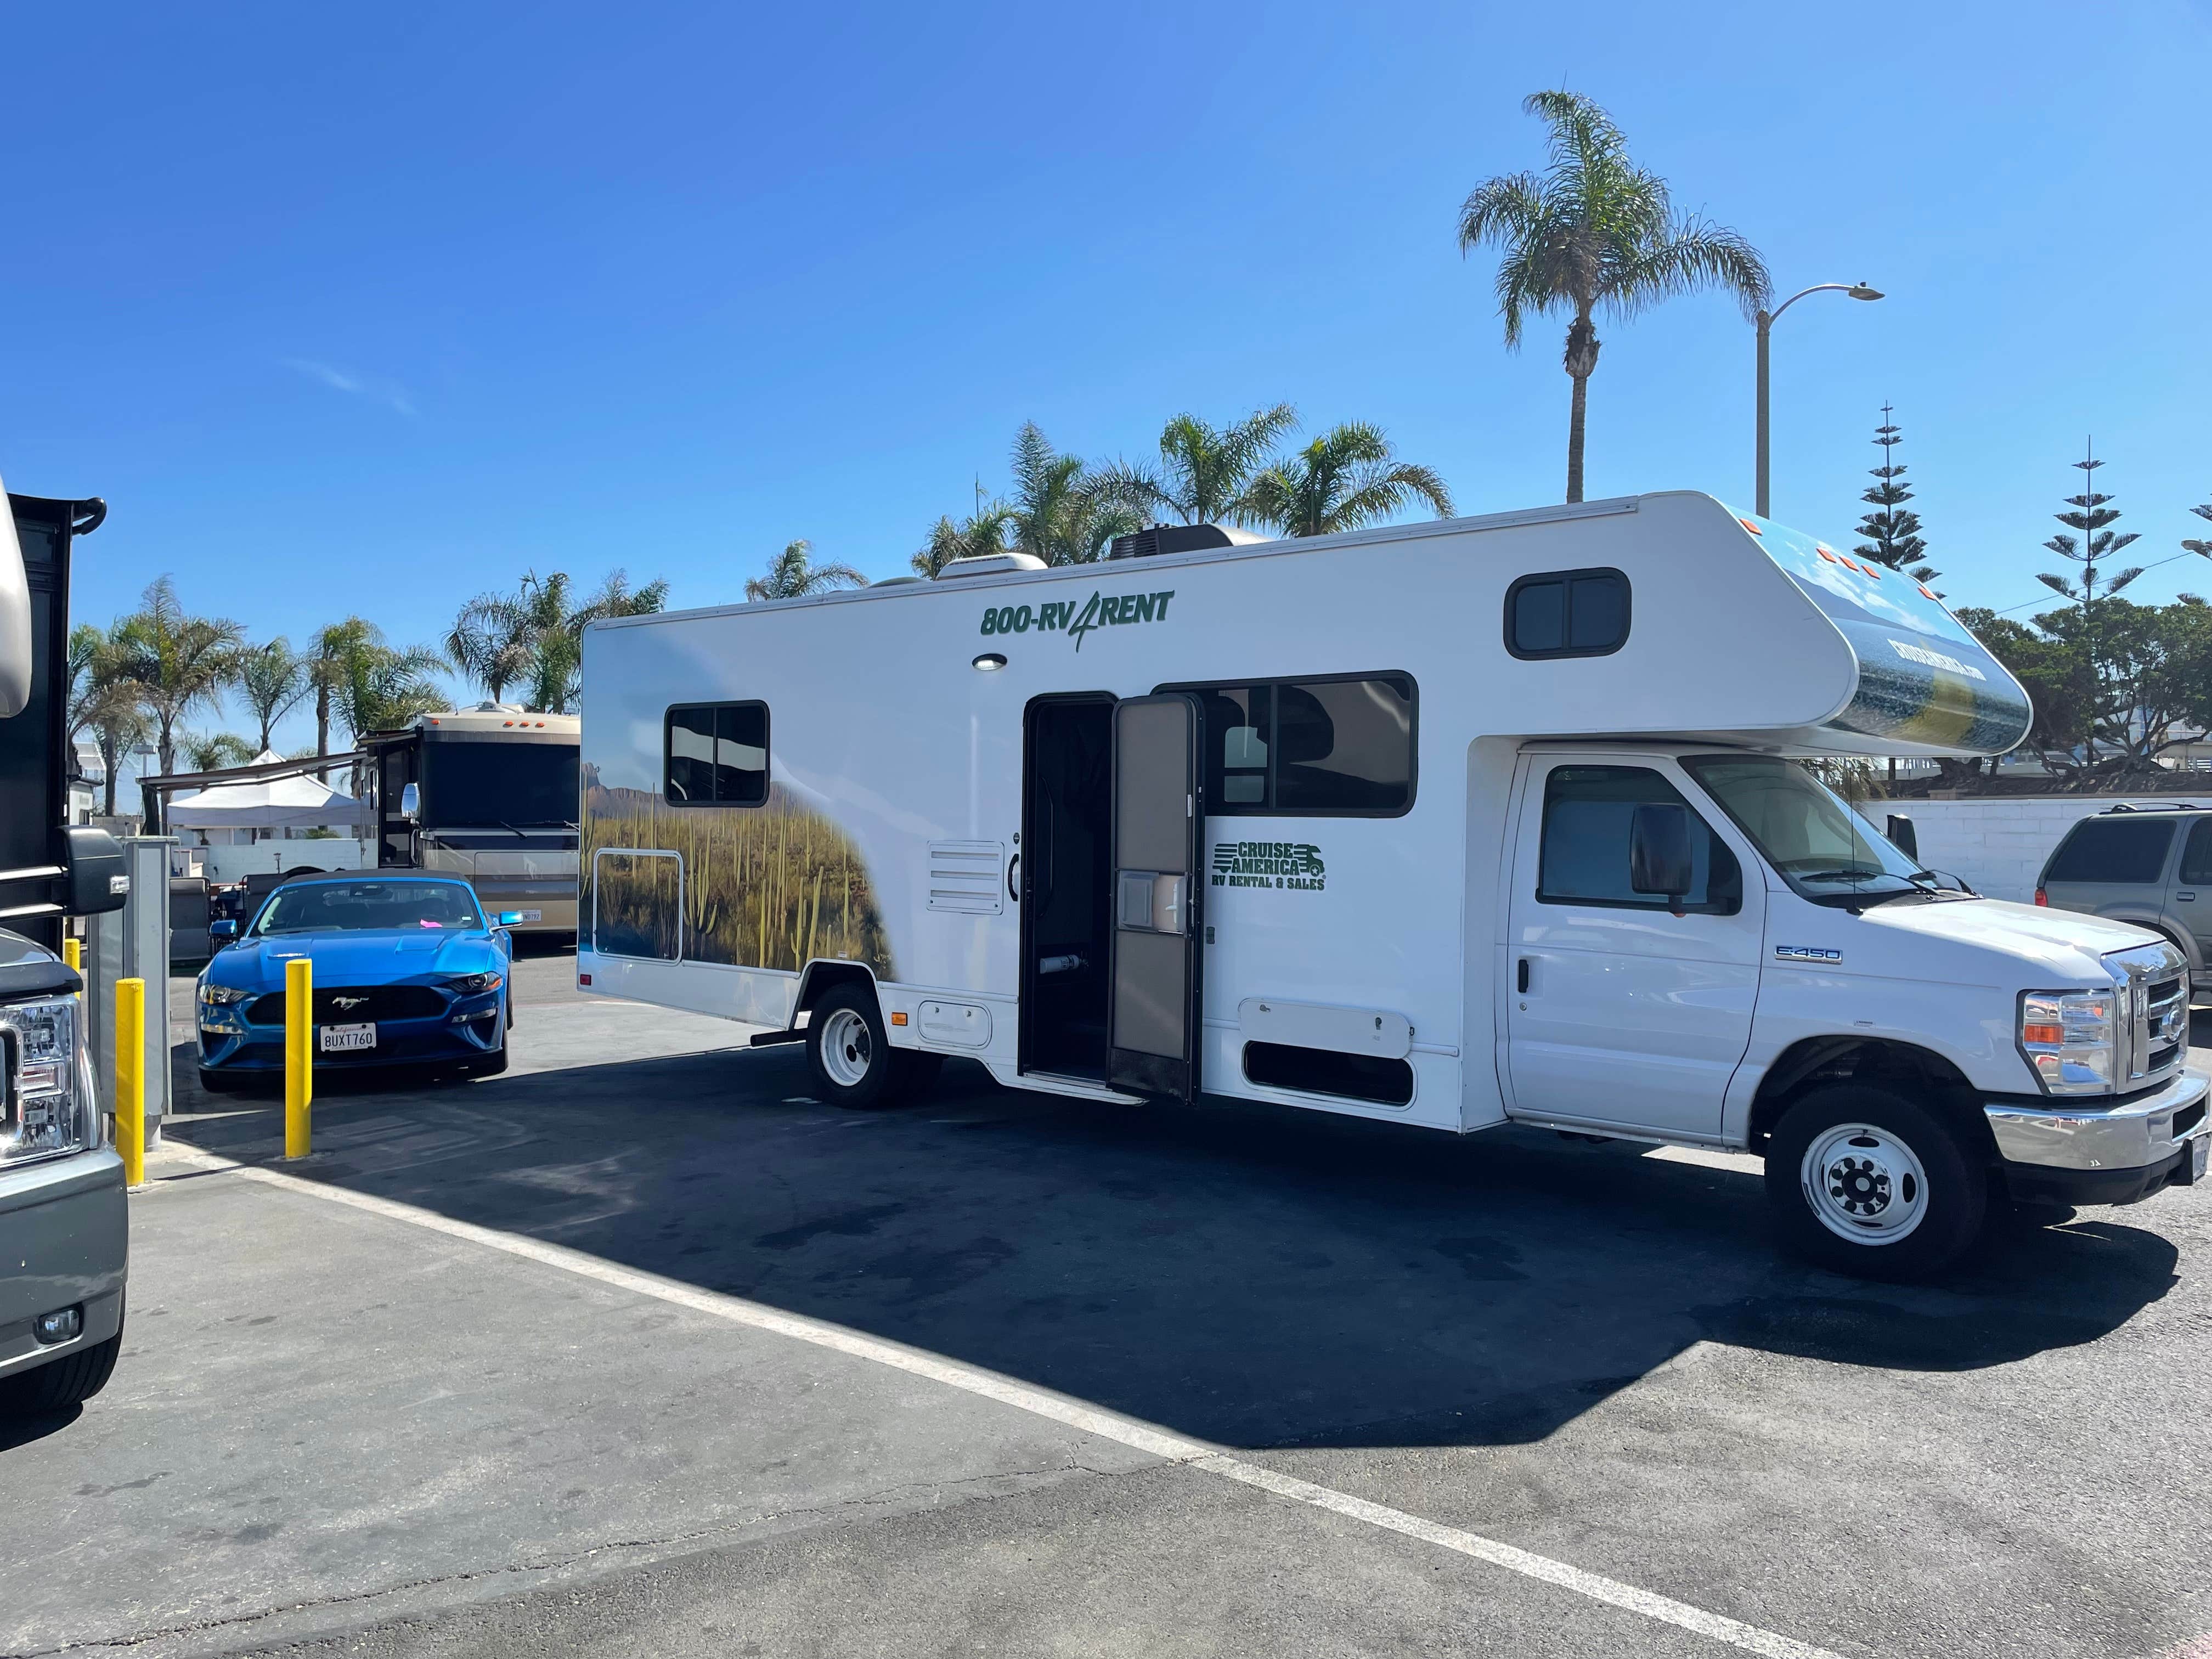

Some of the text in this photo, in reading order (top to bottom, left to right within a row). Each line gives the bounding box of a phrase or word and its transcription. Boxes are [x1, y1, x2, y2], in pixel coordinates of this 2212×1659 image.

[1238, 842, 1293, 859] CRUISE
[1231, 858, 1300, 876] AMERICA
[1211, 874, 1325, 891] RV RENTAL & SALES
[1776, 946, 1840, 959] E-450
[325, 1033, 372, 1047] 8UXT760
